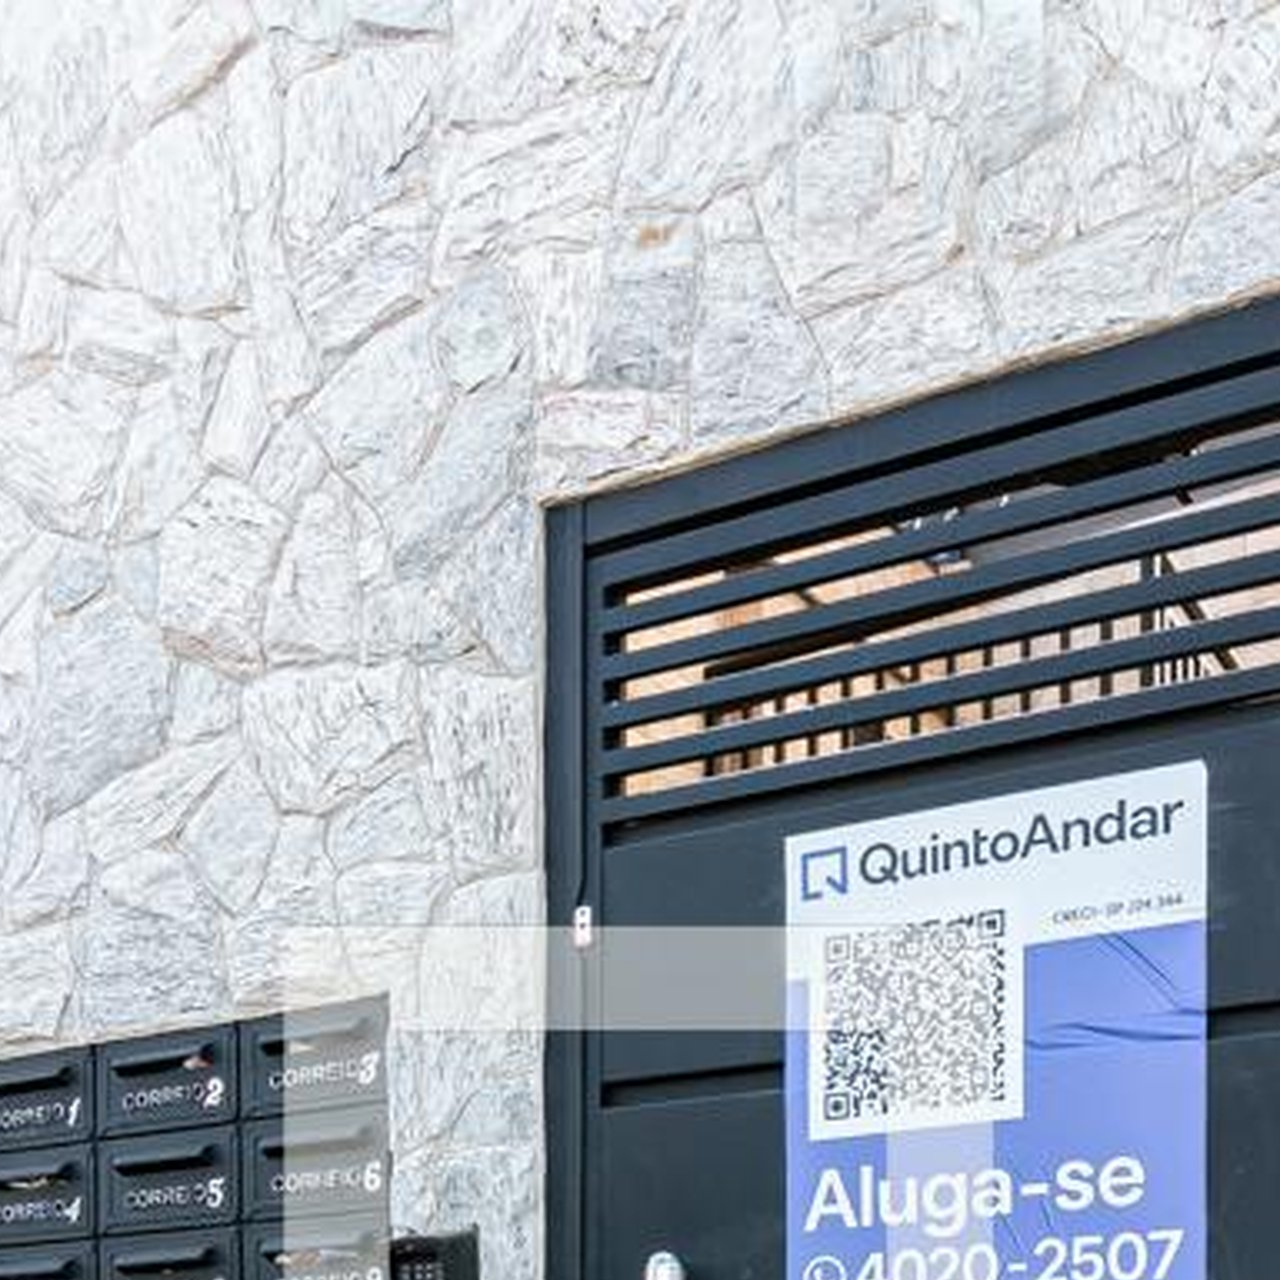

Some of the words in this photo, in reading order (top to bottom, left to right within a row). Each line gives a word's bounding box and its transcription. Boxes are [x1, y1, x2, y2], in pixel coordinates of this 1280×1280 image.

[859, 799, 1185, 885] QuintoAndar
[358, 1051, 380, 1084] 3
[203, 1077, 224, 1109] 2
[68, 1097, 81, 1126] 1
[363, 1160, 381, 1191] 6
[205, 1177, 225, 1209] 5
[804, 1155, 1146, 1238] Aluga-se
[64, 1196, 82, 1223] 4
